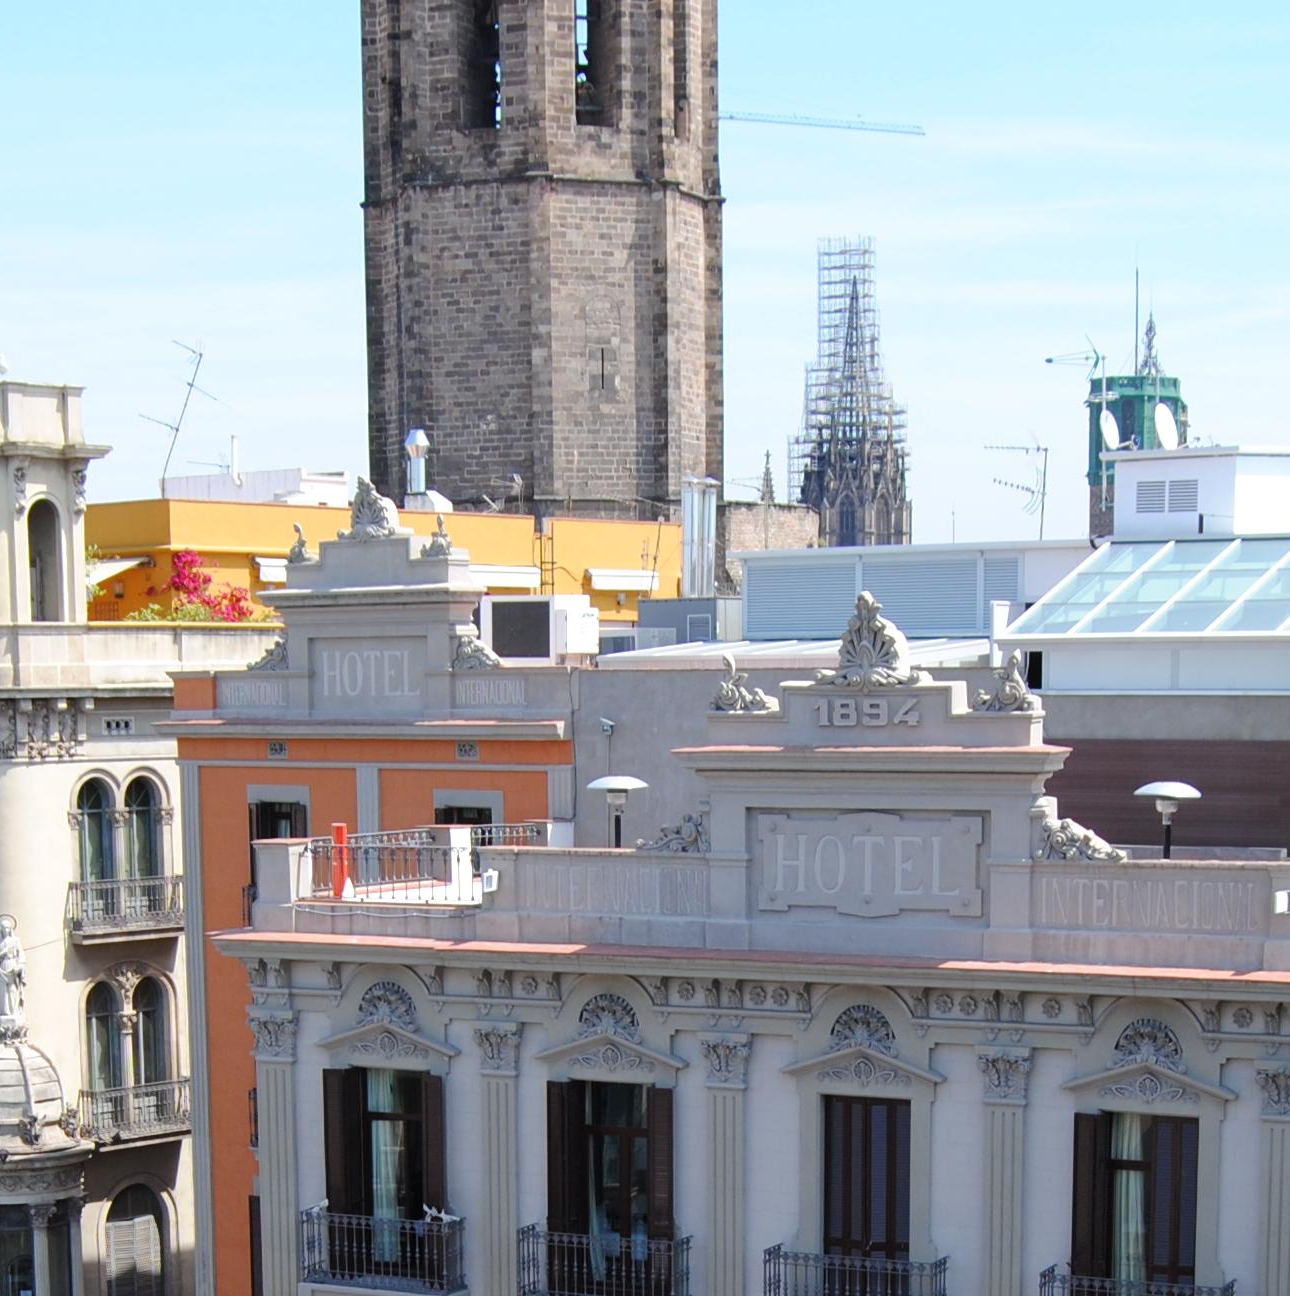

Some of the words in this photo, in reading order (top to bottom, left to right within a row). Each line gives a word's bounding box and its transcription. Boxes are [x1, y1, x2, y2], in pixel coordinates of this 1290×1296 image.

[321, 650, 421, 697] HOTEL
[455, 679, 528, 706] INTERNACIONAL
[814, 698, 920, 727] 1894
[774, 833, 961, 896] HOTEL
[1040, 877, 1258, 931] INTERNACIONAL
